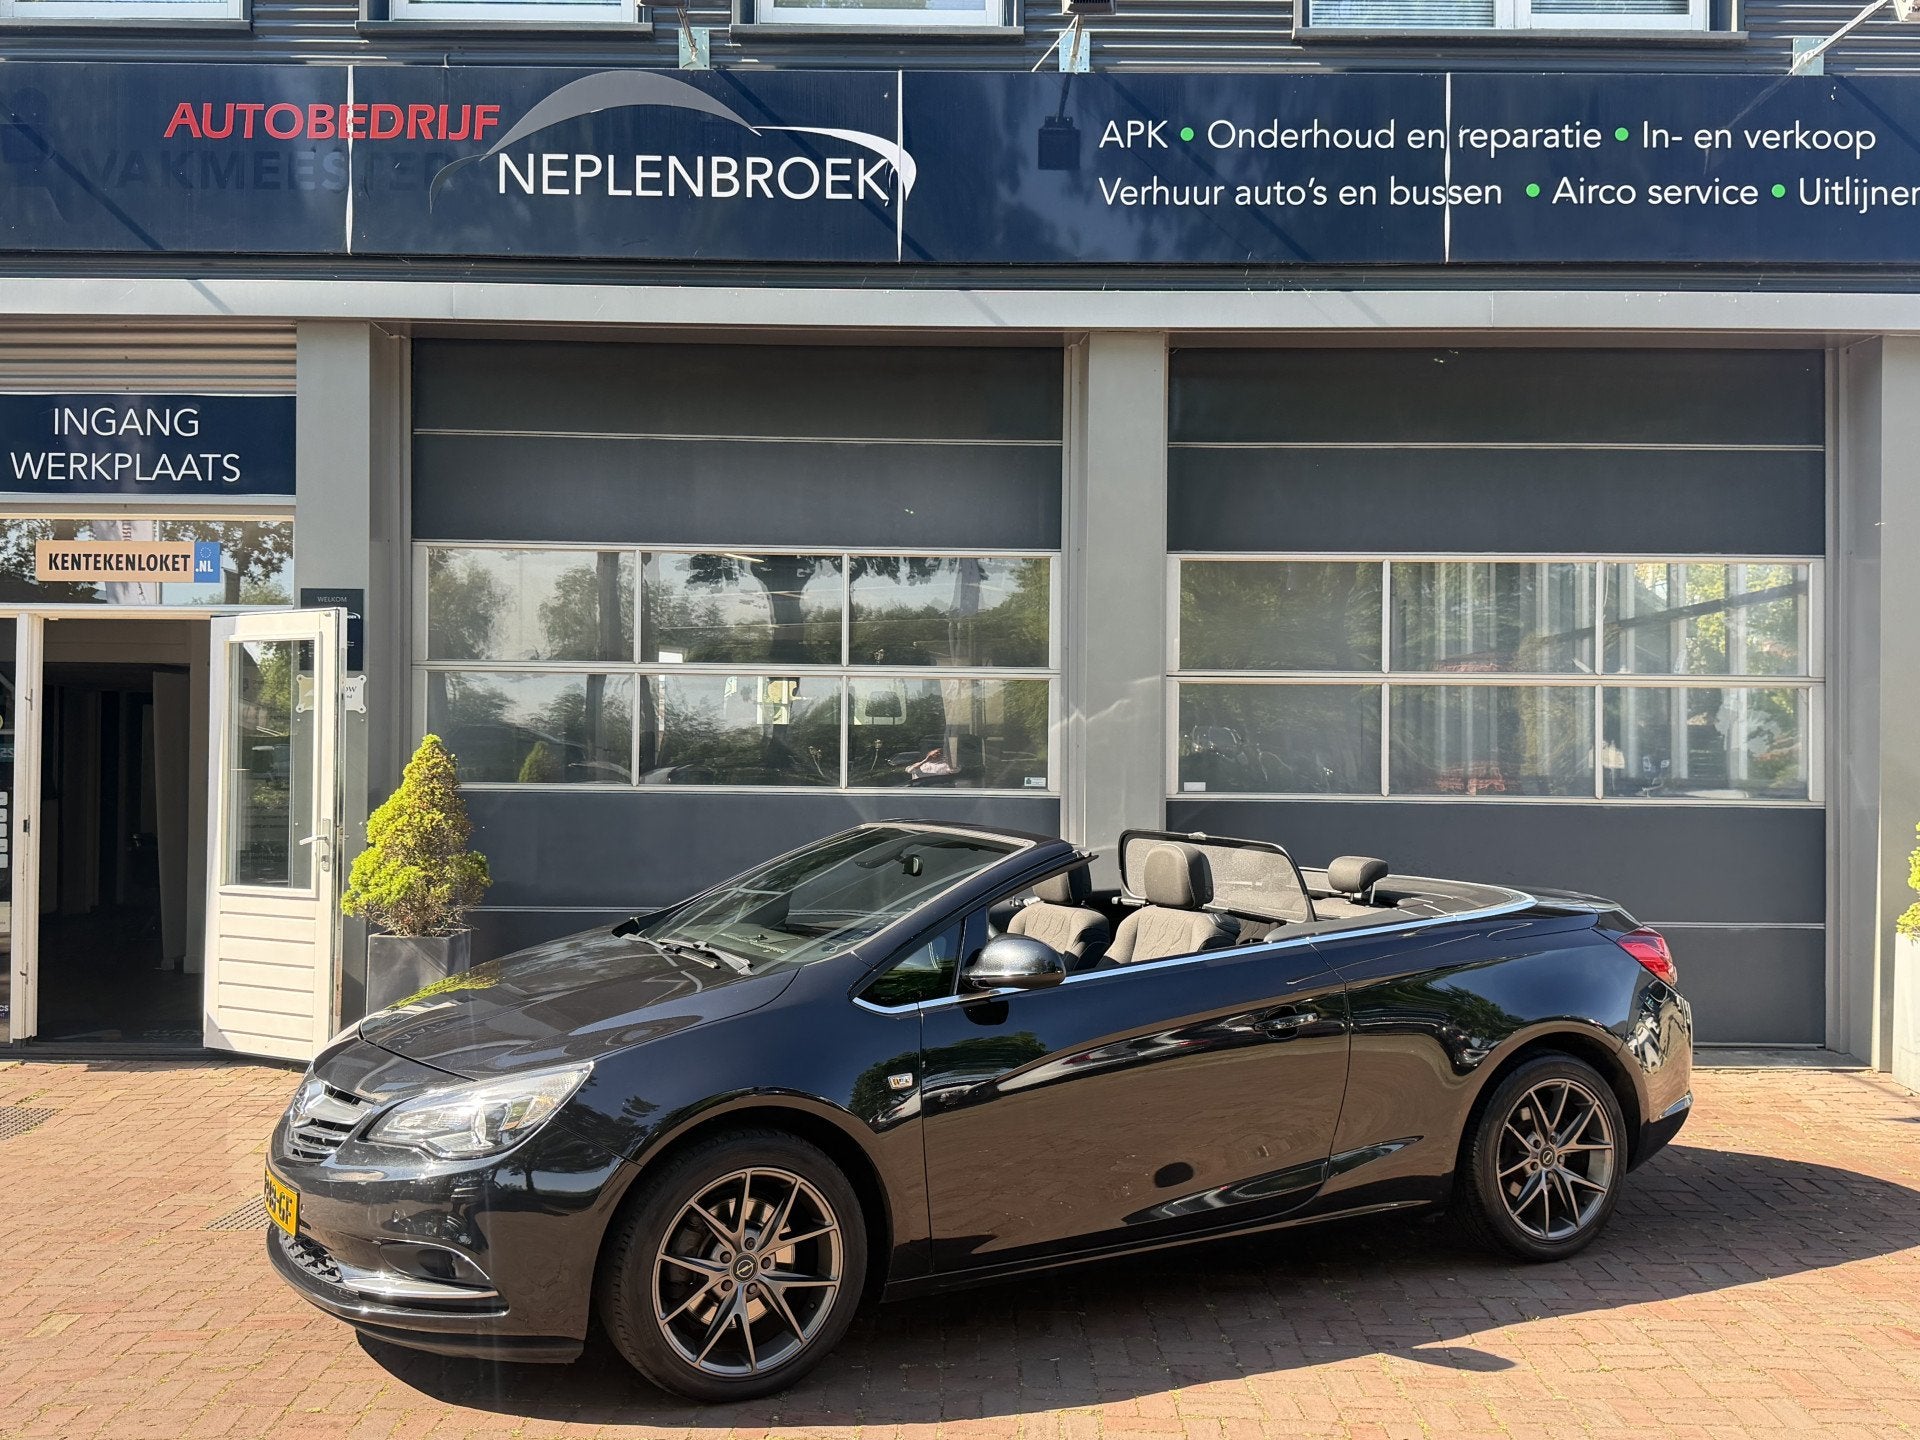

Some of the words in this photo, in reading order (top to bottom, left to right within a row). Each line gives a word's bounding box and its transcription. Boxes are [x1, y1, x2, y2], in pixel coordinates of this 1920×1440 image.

[164, 102, 500, 141] AUTOBEDRIJF
[1098, 119, 1169, 149] APK
[1207, 118, 1395, 149] Onderhoud
[1407, 128, 1445, 149] en
[1458, 119, 1602, 159] reparatie
[1643, 119, 1683, 149] In-
[1693, 128, 1732, 149] en
[1743, 119, 1876, 160] verkoop
[498, 152, 889, 200] NEPLENBROEK
[1098, 175, 1225, 206] Verhuur
[1338, 184, 1377, 206] en
[1390, 176, 1502, 206] bussen
[1551, 176, 1637, 205] Airco
[1647, 176, 1759, 205] service
[53, 407, 199, 437] INGANG
[10, 452, 241, 482] WERKPLAATS
